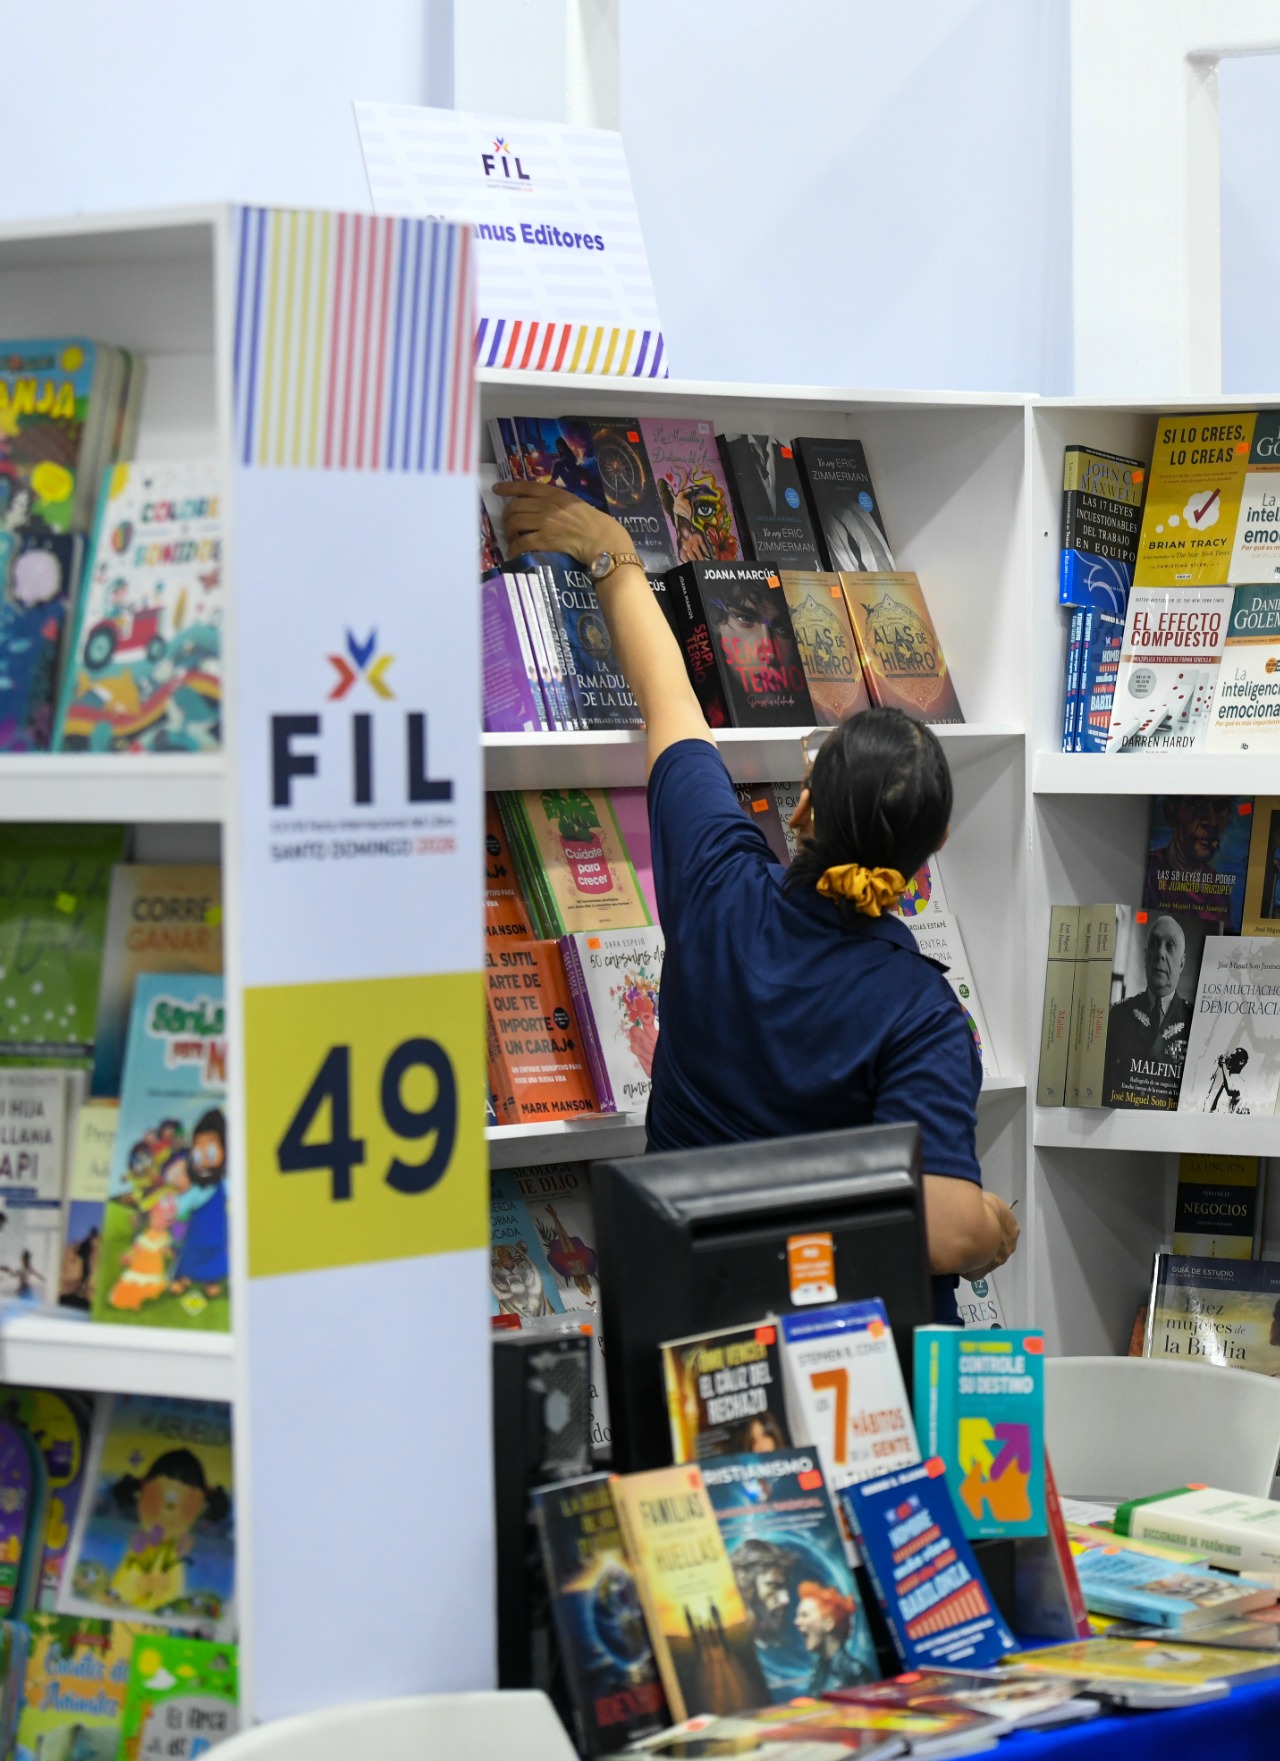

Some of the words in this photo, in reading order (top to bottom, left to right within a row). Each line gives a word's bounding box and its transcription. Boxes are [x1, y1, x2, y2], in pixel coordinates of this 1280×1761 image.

[481, 154, 530, 181] FIL
[520, 223, 605, 251] Editores
[1163, 429, 1177, 444] SI
[1180, 428, 1197, 443] LO
[1201, 425, 1246, 442] CREES,
[1170, 451, 1187, 465] LO
[1191, 447, 1233, 464] CREAS
[812, 471, 868, 482] ZIMMERMAN
[1082, 475, 1137, 503] MAXWELL
[1082, 495, 1096, 508] LAS
[1100, 500, 1107, 510] 17
[1109, 502, 1133, 518] LEYES
[1261, 493, 1276, 508] La
[1076, 508, 1138, 533] INCUESTIONABLES
[1083, 525, 1096, 537] DEL
[1099, 528, 1130, 546] TRABAJO
[1149, 539, 1186, 550] BRIAN
[1190, 537, 1228, 548] TRACY
[758, 541, 815, 552] ZIMMERMAN
[1076, 537, 1089, 549] EN
[1095, 544, 1136, 562] EQUIPO
[704, 569, 736, 581] JOANA
[737, 568, 775, 581] MARCÚS
[1133, 612, 1150, 632] EL
[1158, 612, 1222, 632] EFECTO
[796, 627, 831, 648] ALAS
[836, 636, 847, 648] DE
[873, 627, 915, 646] ALAS
[916, 634, 928, 645] DE
[1130, 630, 1219, 647] COMPUESTO
[721, 638, 781, 665] SEMPI
[597, 662, 608, 672] LA
[880, 652, 935, 672] HIERRO
[736, 666, 806, 693] TERNO
[1235, 667, 1247, 681] La
[1122, 736, 1160, 747] DARREN
[1163, 735, 1195, 747] HARDY
[270, 712, 454, 808] FIL
[578, 862, 600, 875] para
[1157, 869, 1170, 881] LAS
[1171, 871, 1180, 881] 58
[1182, 872, 1201, 883] LEYES
[1202, 873, 1213, 884] DEL
[1215, 874, 1236, 885] PODER
[578, 875, 608, 886] crecer
[604, 940, 622, 949] SARA
[623, 938, 645, 947] ESPEJO
[485, 952, 497, 968] EL
[500, 951, 538, 967] SUTIL
[1217, 961, 1229, 969] José
[1229, 962, 1248, 971] Miguel
[490, 974, 521, 989] ARTE
[523, 973, 541, 988] DE
[1202, 983, 1221, 994] LOS
[493, 997, 519, 1011] QUE
[522, 996, 538, 1010] TE
[500, 1016, 553, 1032] IMPORTE
[1130, 1057, 1181, 1079] MALFINÍ
[521, 1103, 550, 1114] MARK
[551, 1099, 593, 1112] MANSON
[1110, 1089, 1123, 1101] José
[1125, 1091, 1149, 1106] Miguel
[1151, 1094, 1166, 1107] Soto
[275, 1035, 460, 1204] 49
[1183, 1201, 1248, 1217] NEGOCIOS
[1171, 1266, 1189, 1275] GUÍA
[1203, 1269, 1234, 1277] ESTUDIO
[959, 1355, 1025, 1374] CONTROLE
[700, 1374, 713, 1397] EL
[750, 1362, 772, 1388] DEL
[959, 1376, 976, 1394] SU
[977, 1376, 1033, 1394] DESTINO
[707, 1388, 767, 1425] RECHAZO
[810, 1368, 848, 1466] 7
[853, 1408, 906, 1436] HÁBITOS
[1143, 1527, 1187, 1549] DICCIONARIO
[1190, 1535, 1199, 1552] DE
[1201, 1537, 1242, 1557] PARÓNIMOS
